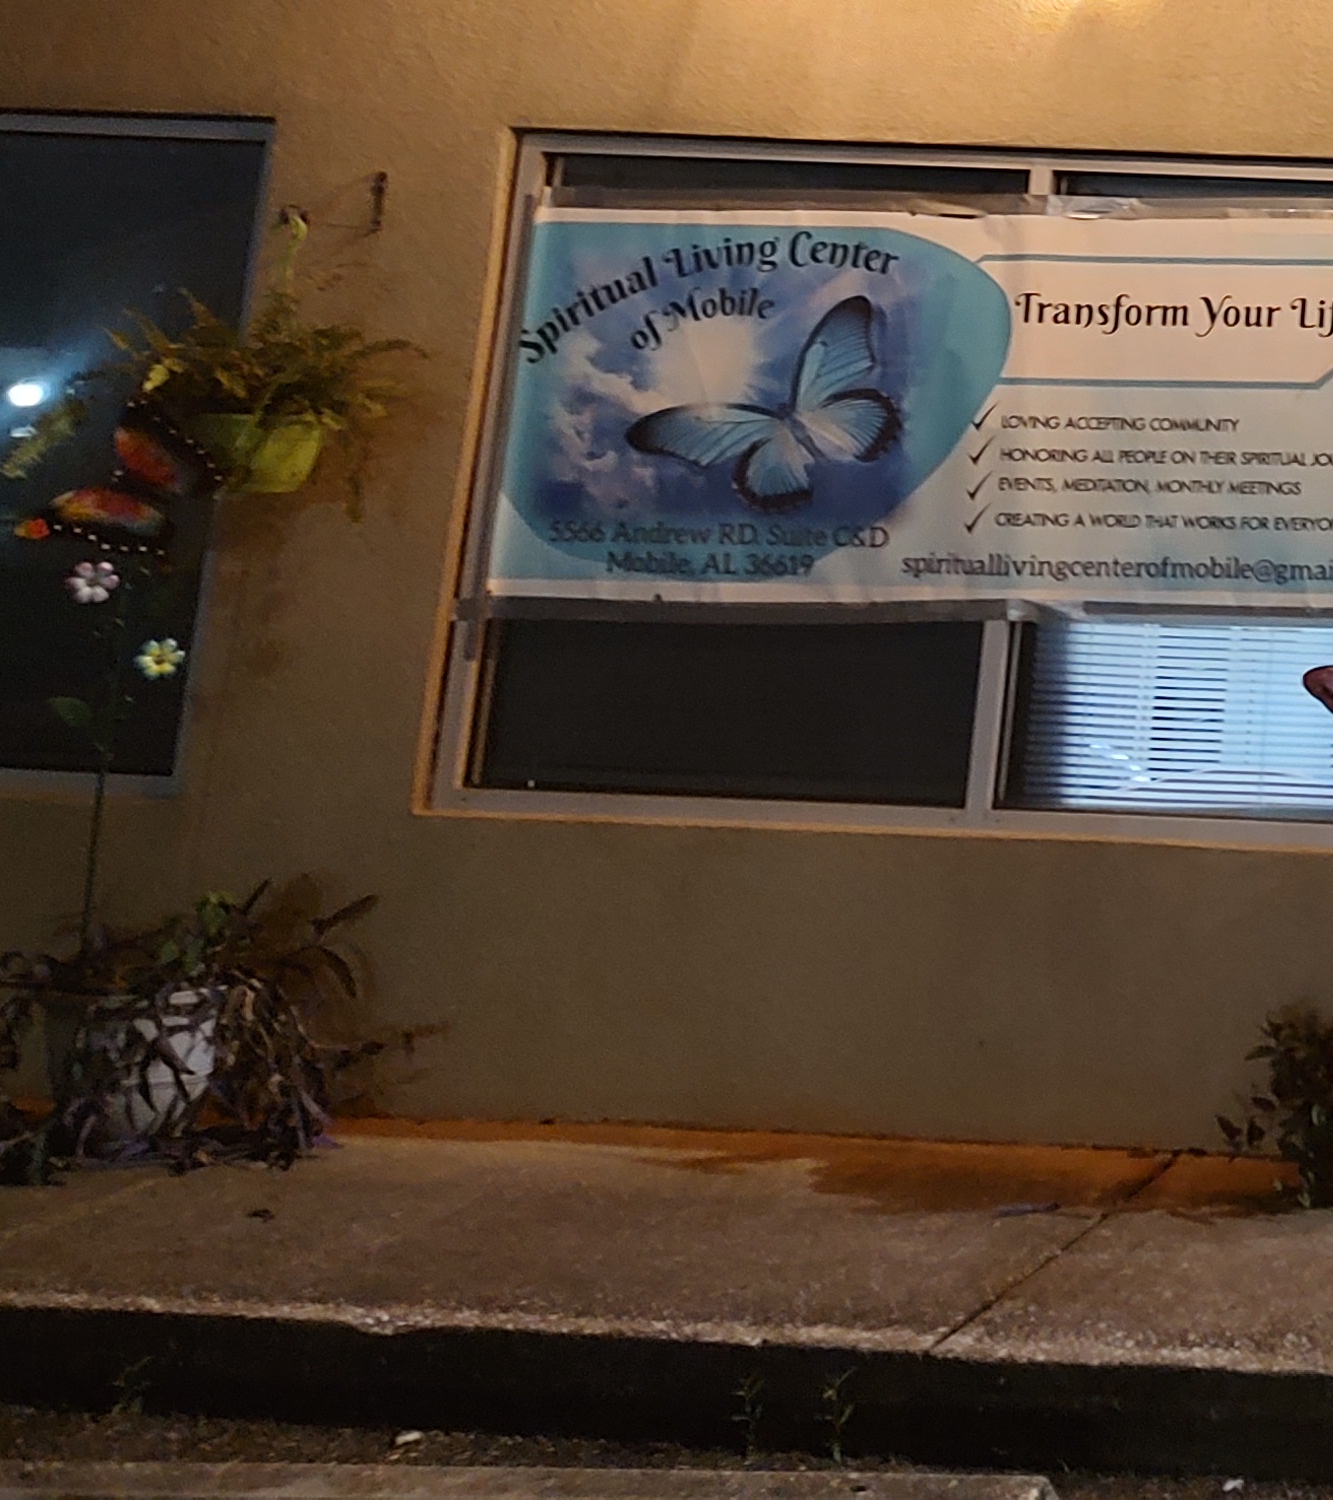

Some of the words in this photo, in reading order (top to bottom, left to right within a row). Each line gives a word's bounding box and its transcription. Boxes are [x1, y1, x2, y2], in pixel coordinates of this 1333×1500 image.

[518, 257, 659, 364] Spiritual
[663, 237, 781, 280] Living
[788, 231, 900, 275] Center
[630, 311, 664, 351] of
[663, 286, 775, 332] Mobile
[1014, 292, 1190, 335] Transform
[1196, 294, 1282, 338] Your
[1000, 415, 1062, 430] LOVING
[1064, 416, 1147, 431] ACCEPTING
[1149, 417, 1240, 432] COMMUNITY
[1000, 447, 1089, 463] HONORING
[1092, 449, 1115, 464] ALL
[1118, 449, 1167, 464] PEOPLE
[1170, 450, 1196, 465] ON
[1199, 451, 1238, 466] THEIR
[1240, 451, 1307, 467] SPIRITUAL
[1155, 479, 1225, 495] MONTHLY
[1226, 480, 1302, 496] MEETINGS
[993, 511, 1071, 528] CREATING
[1073, 513, 1086, 528] A
[1087, 513, 1142, 529] WORLD
[1144, 514, 1178, 529] THAT
[1180, 515, 1237, 530] WORKS
[1240, 516, 1271, 531] FOR
[831, 525, 891, 548] C&D
[700, 552, 737, 575] AL
